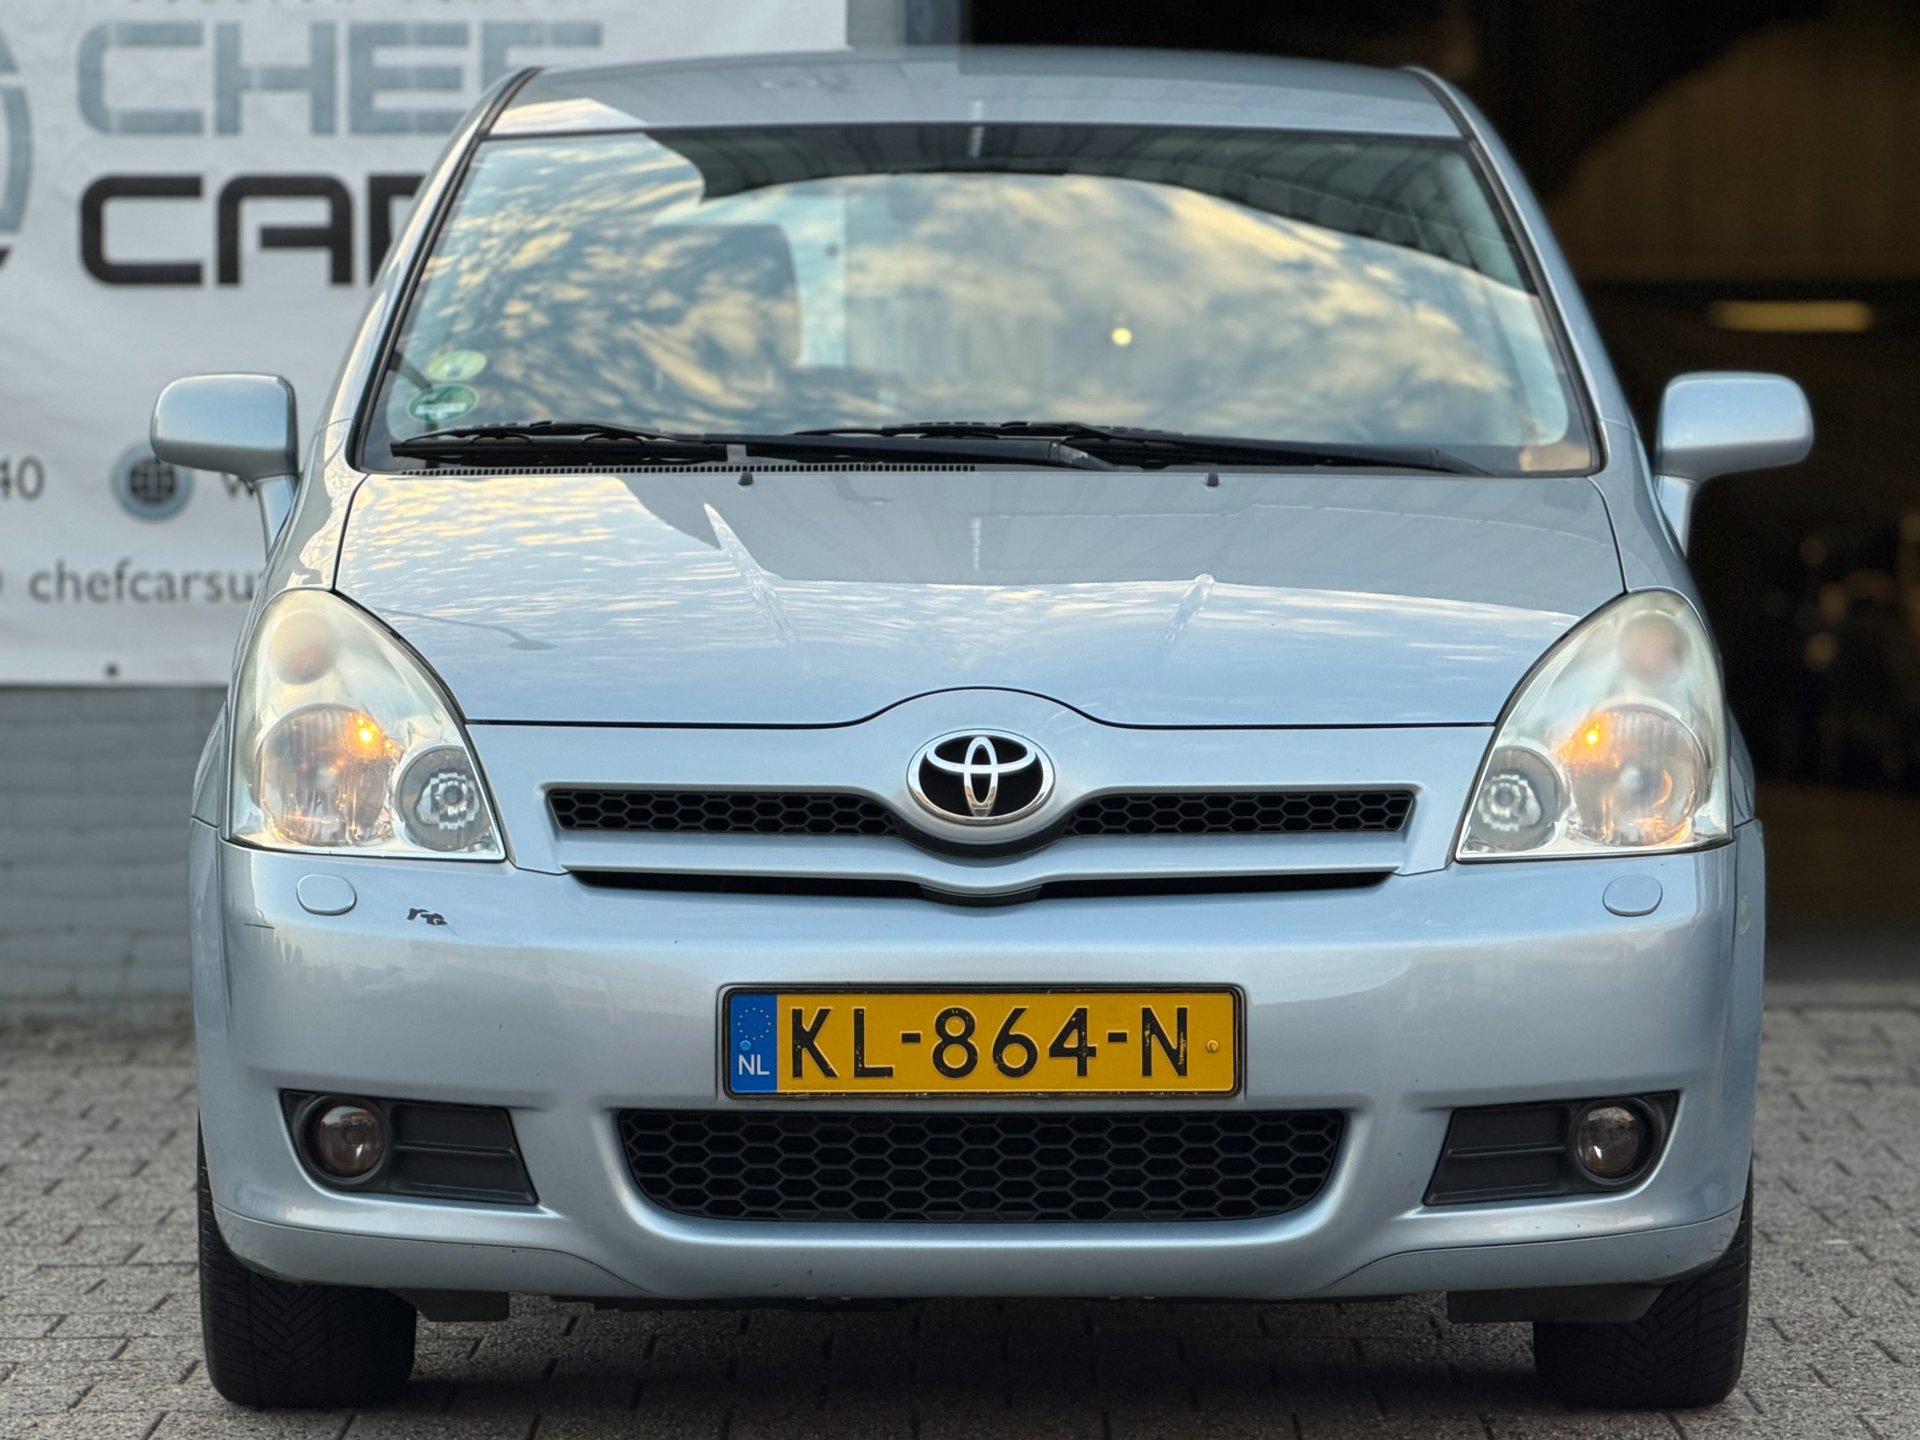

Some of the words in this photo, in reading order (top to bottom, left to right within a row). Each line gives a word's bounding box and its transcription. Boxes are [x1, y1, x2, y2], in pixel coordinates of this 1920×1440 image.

[28, 557, 262, 604] chefcarsu
[738, 1054, 770, 1076] NL
[791, 1007, 1188, 1078] KL-864-N
